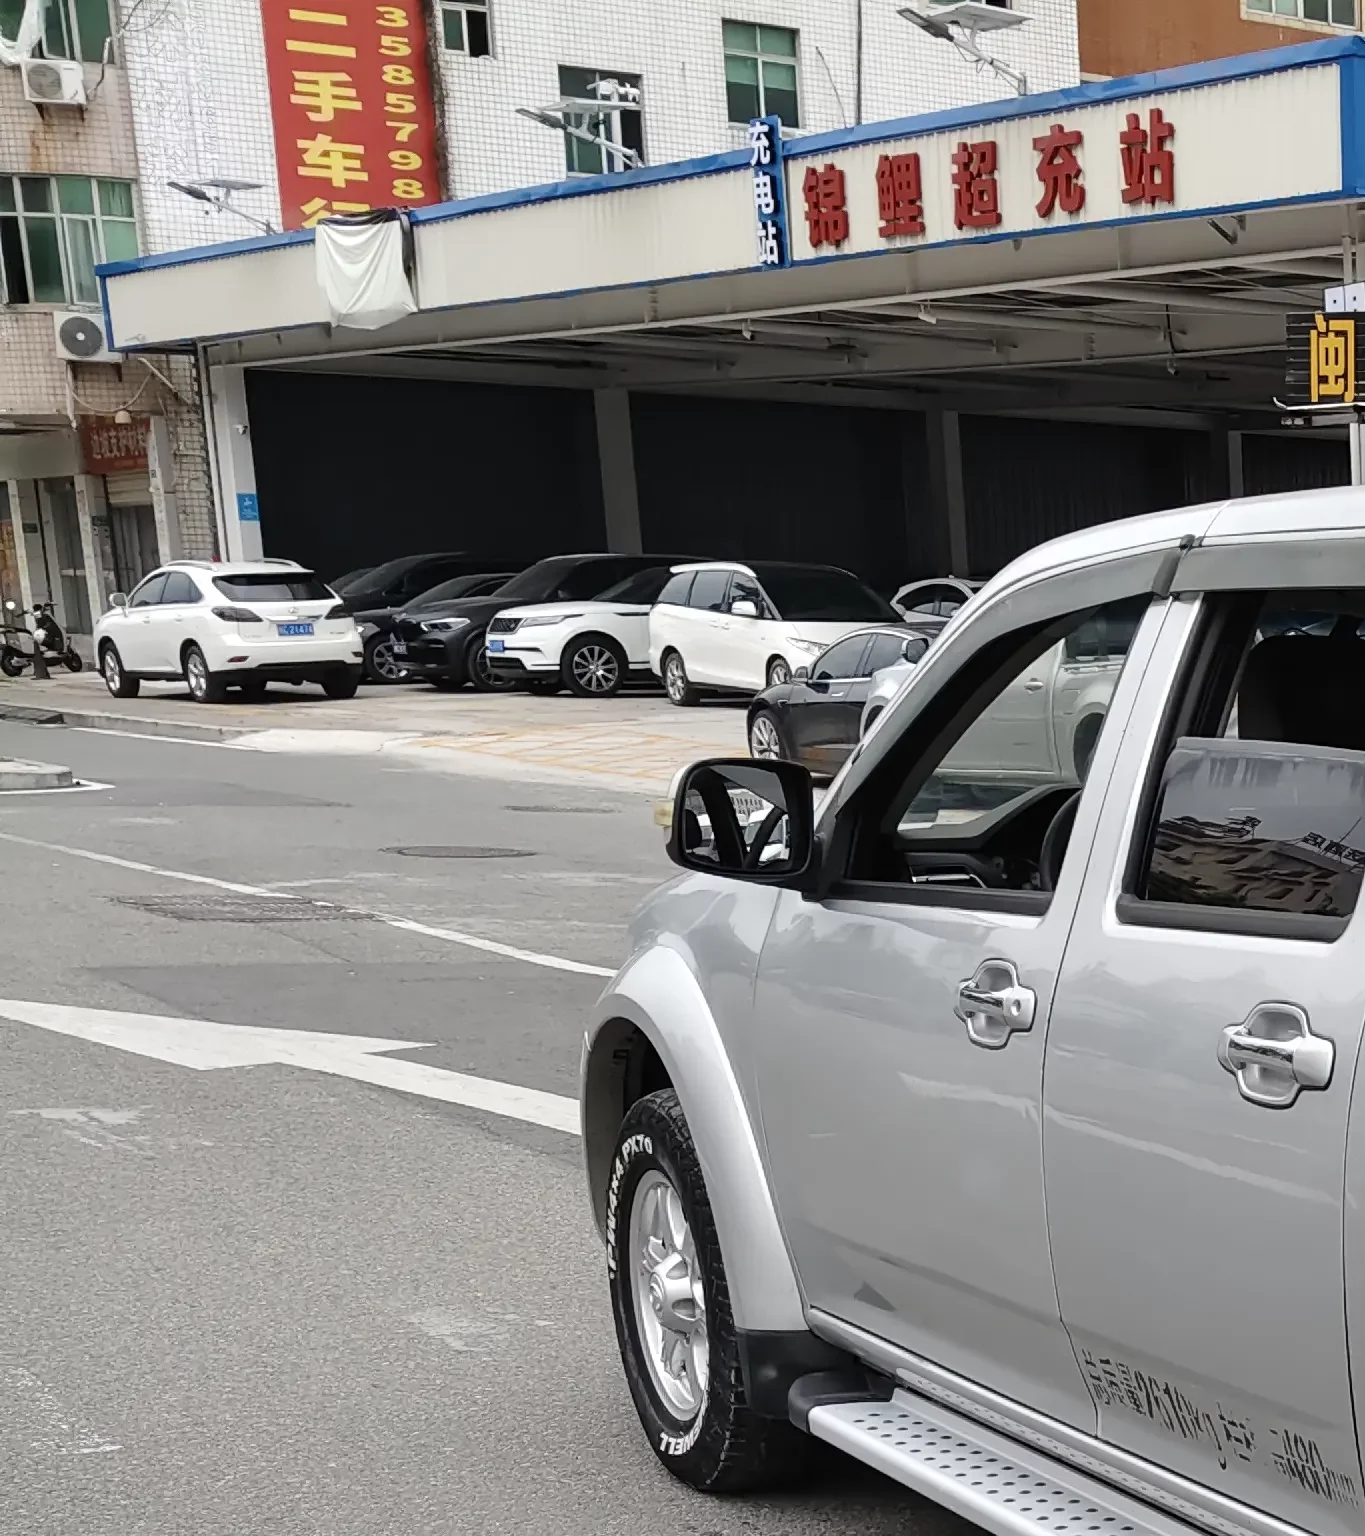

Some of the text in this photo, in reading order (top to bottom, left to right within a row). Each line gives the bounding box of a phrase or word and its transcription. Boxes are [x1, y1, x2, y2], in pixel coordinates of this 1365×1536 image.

[375, 5, 425, 199] 3585798
[747, 120, 781, 266] 充电站
[802, 107, 1176, 249] 锦鲤超充站
